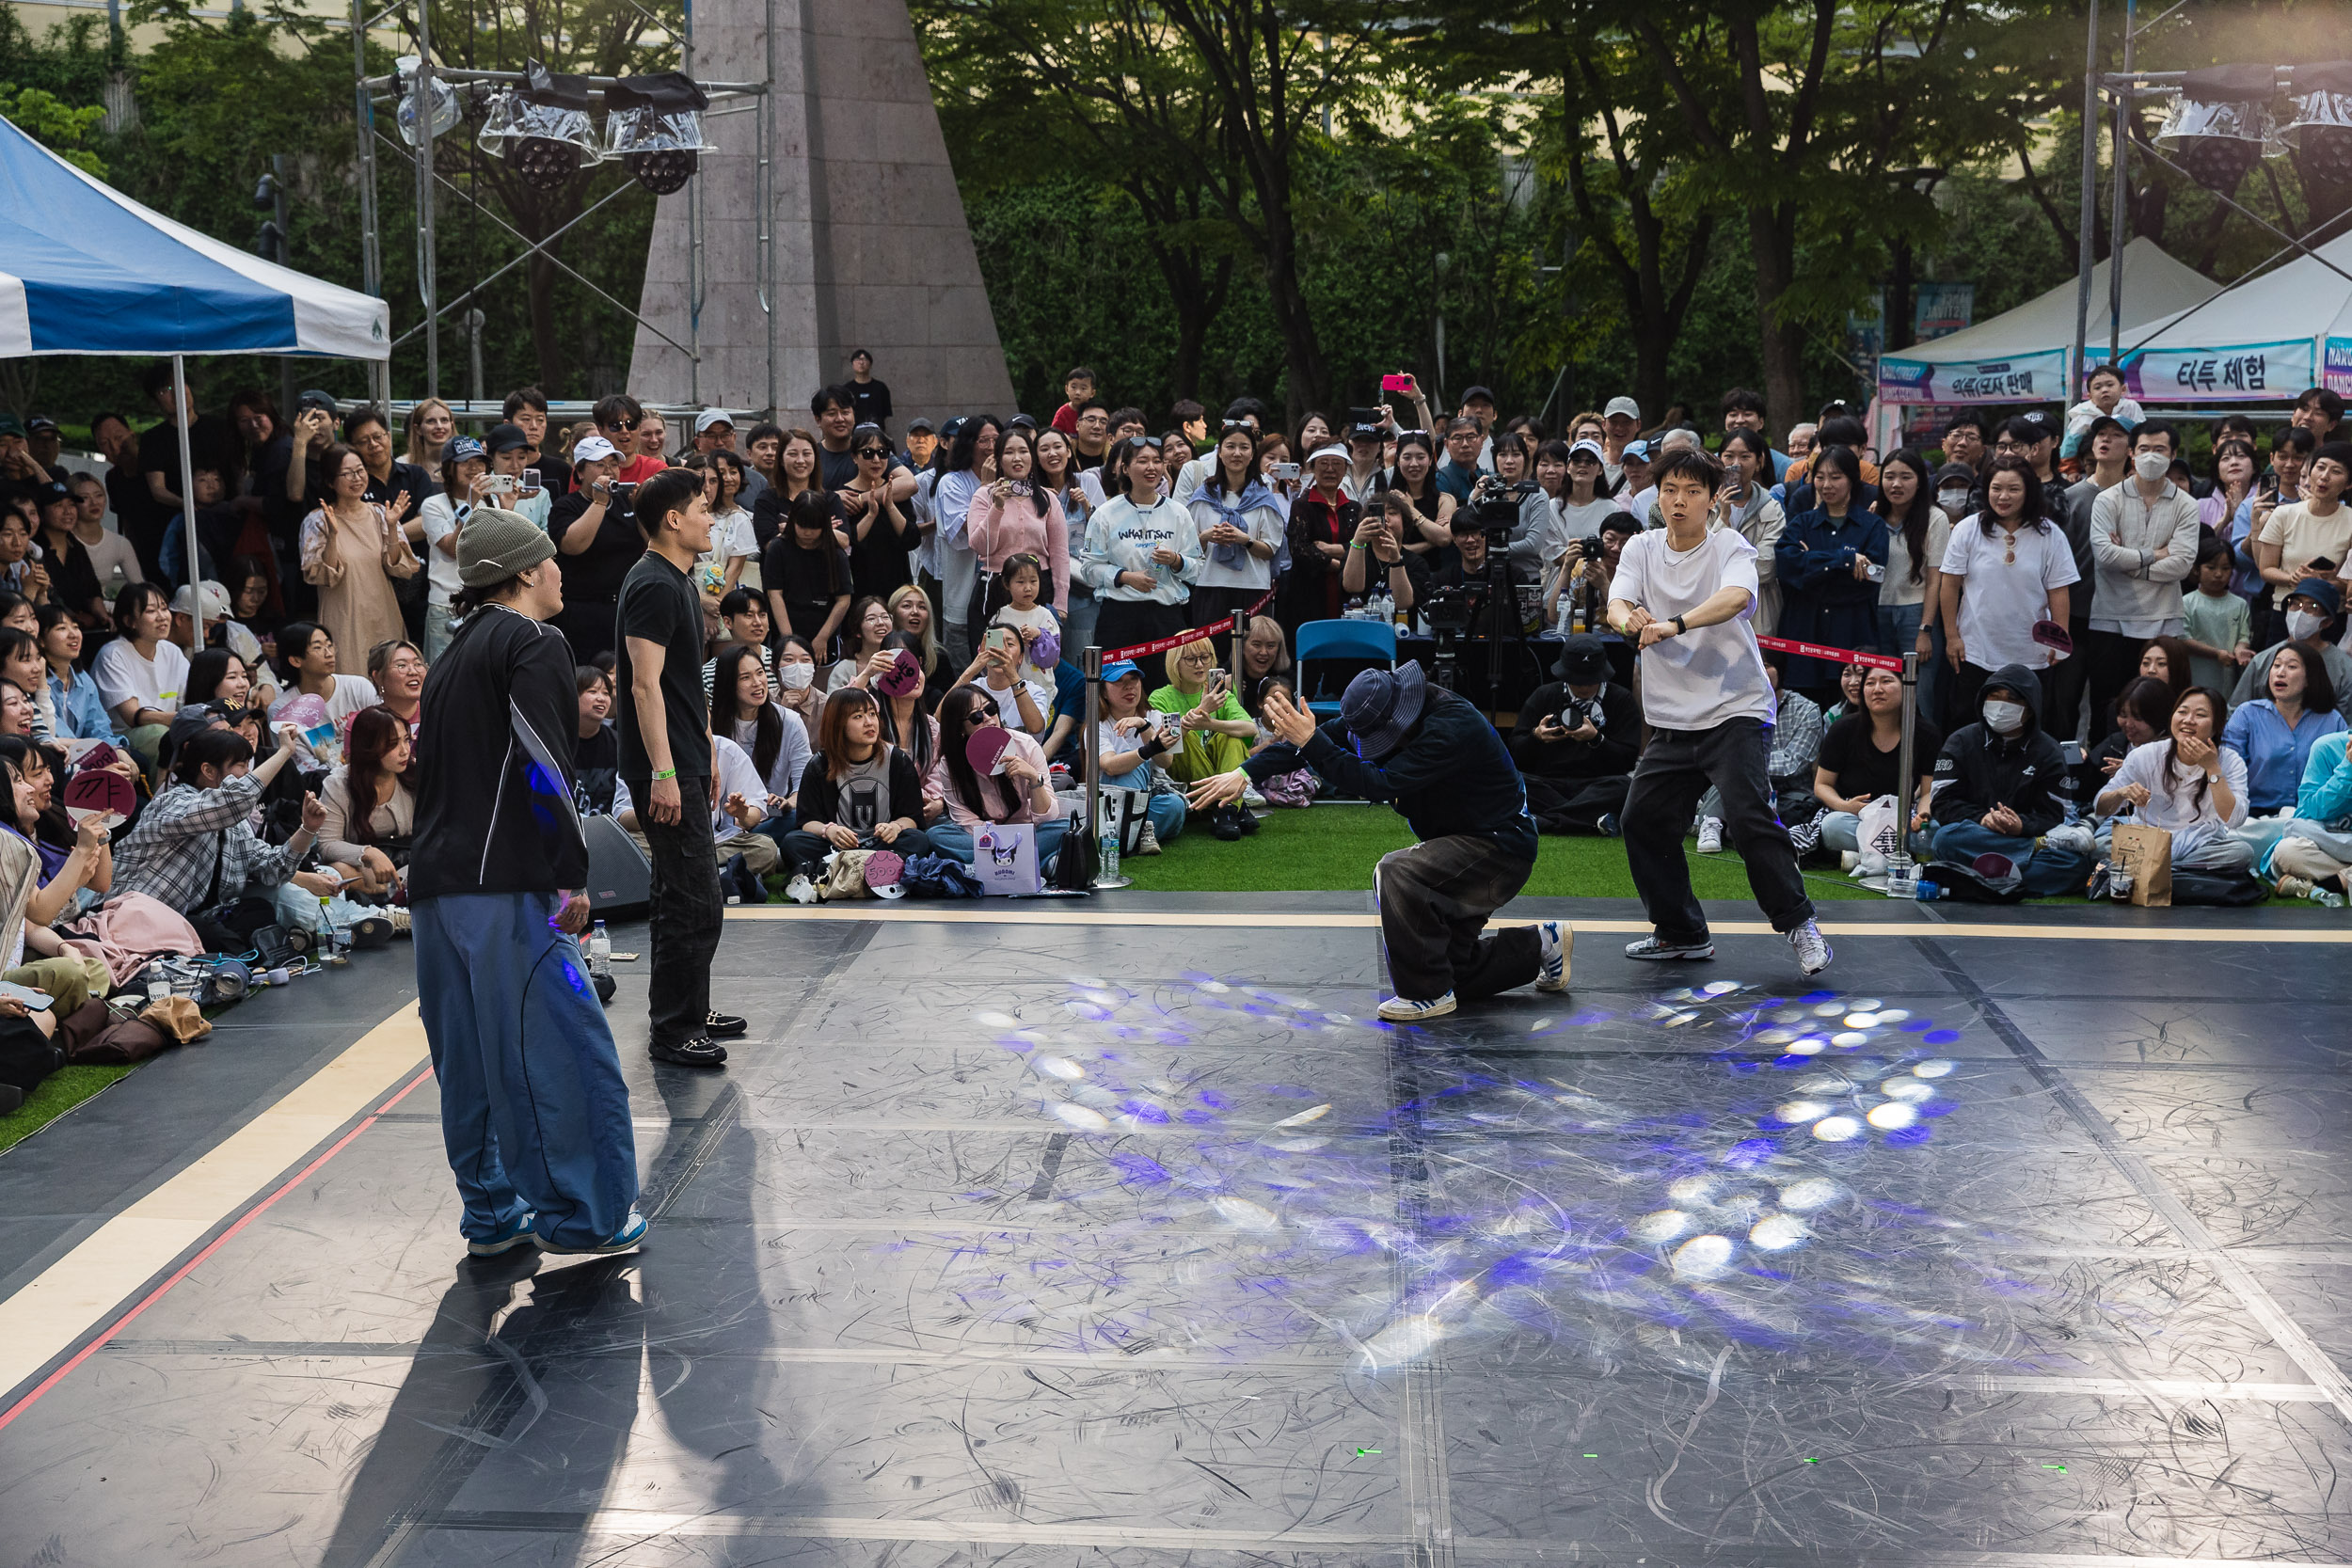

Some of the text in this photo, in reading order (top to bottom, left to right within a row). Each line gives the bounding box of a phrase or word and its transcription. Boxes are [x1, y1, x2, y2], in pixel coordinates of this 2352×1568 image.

[2007, 371, 2034, 395] 판매
[2177, 354, 2266, 391] 타투 체험
